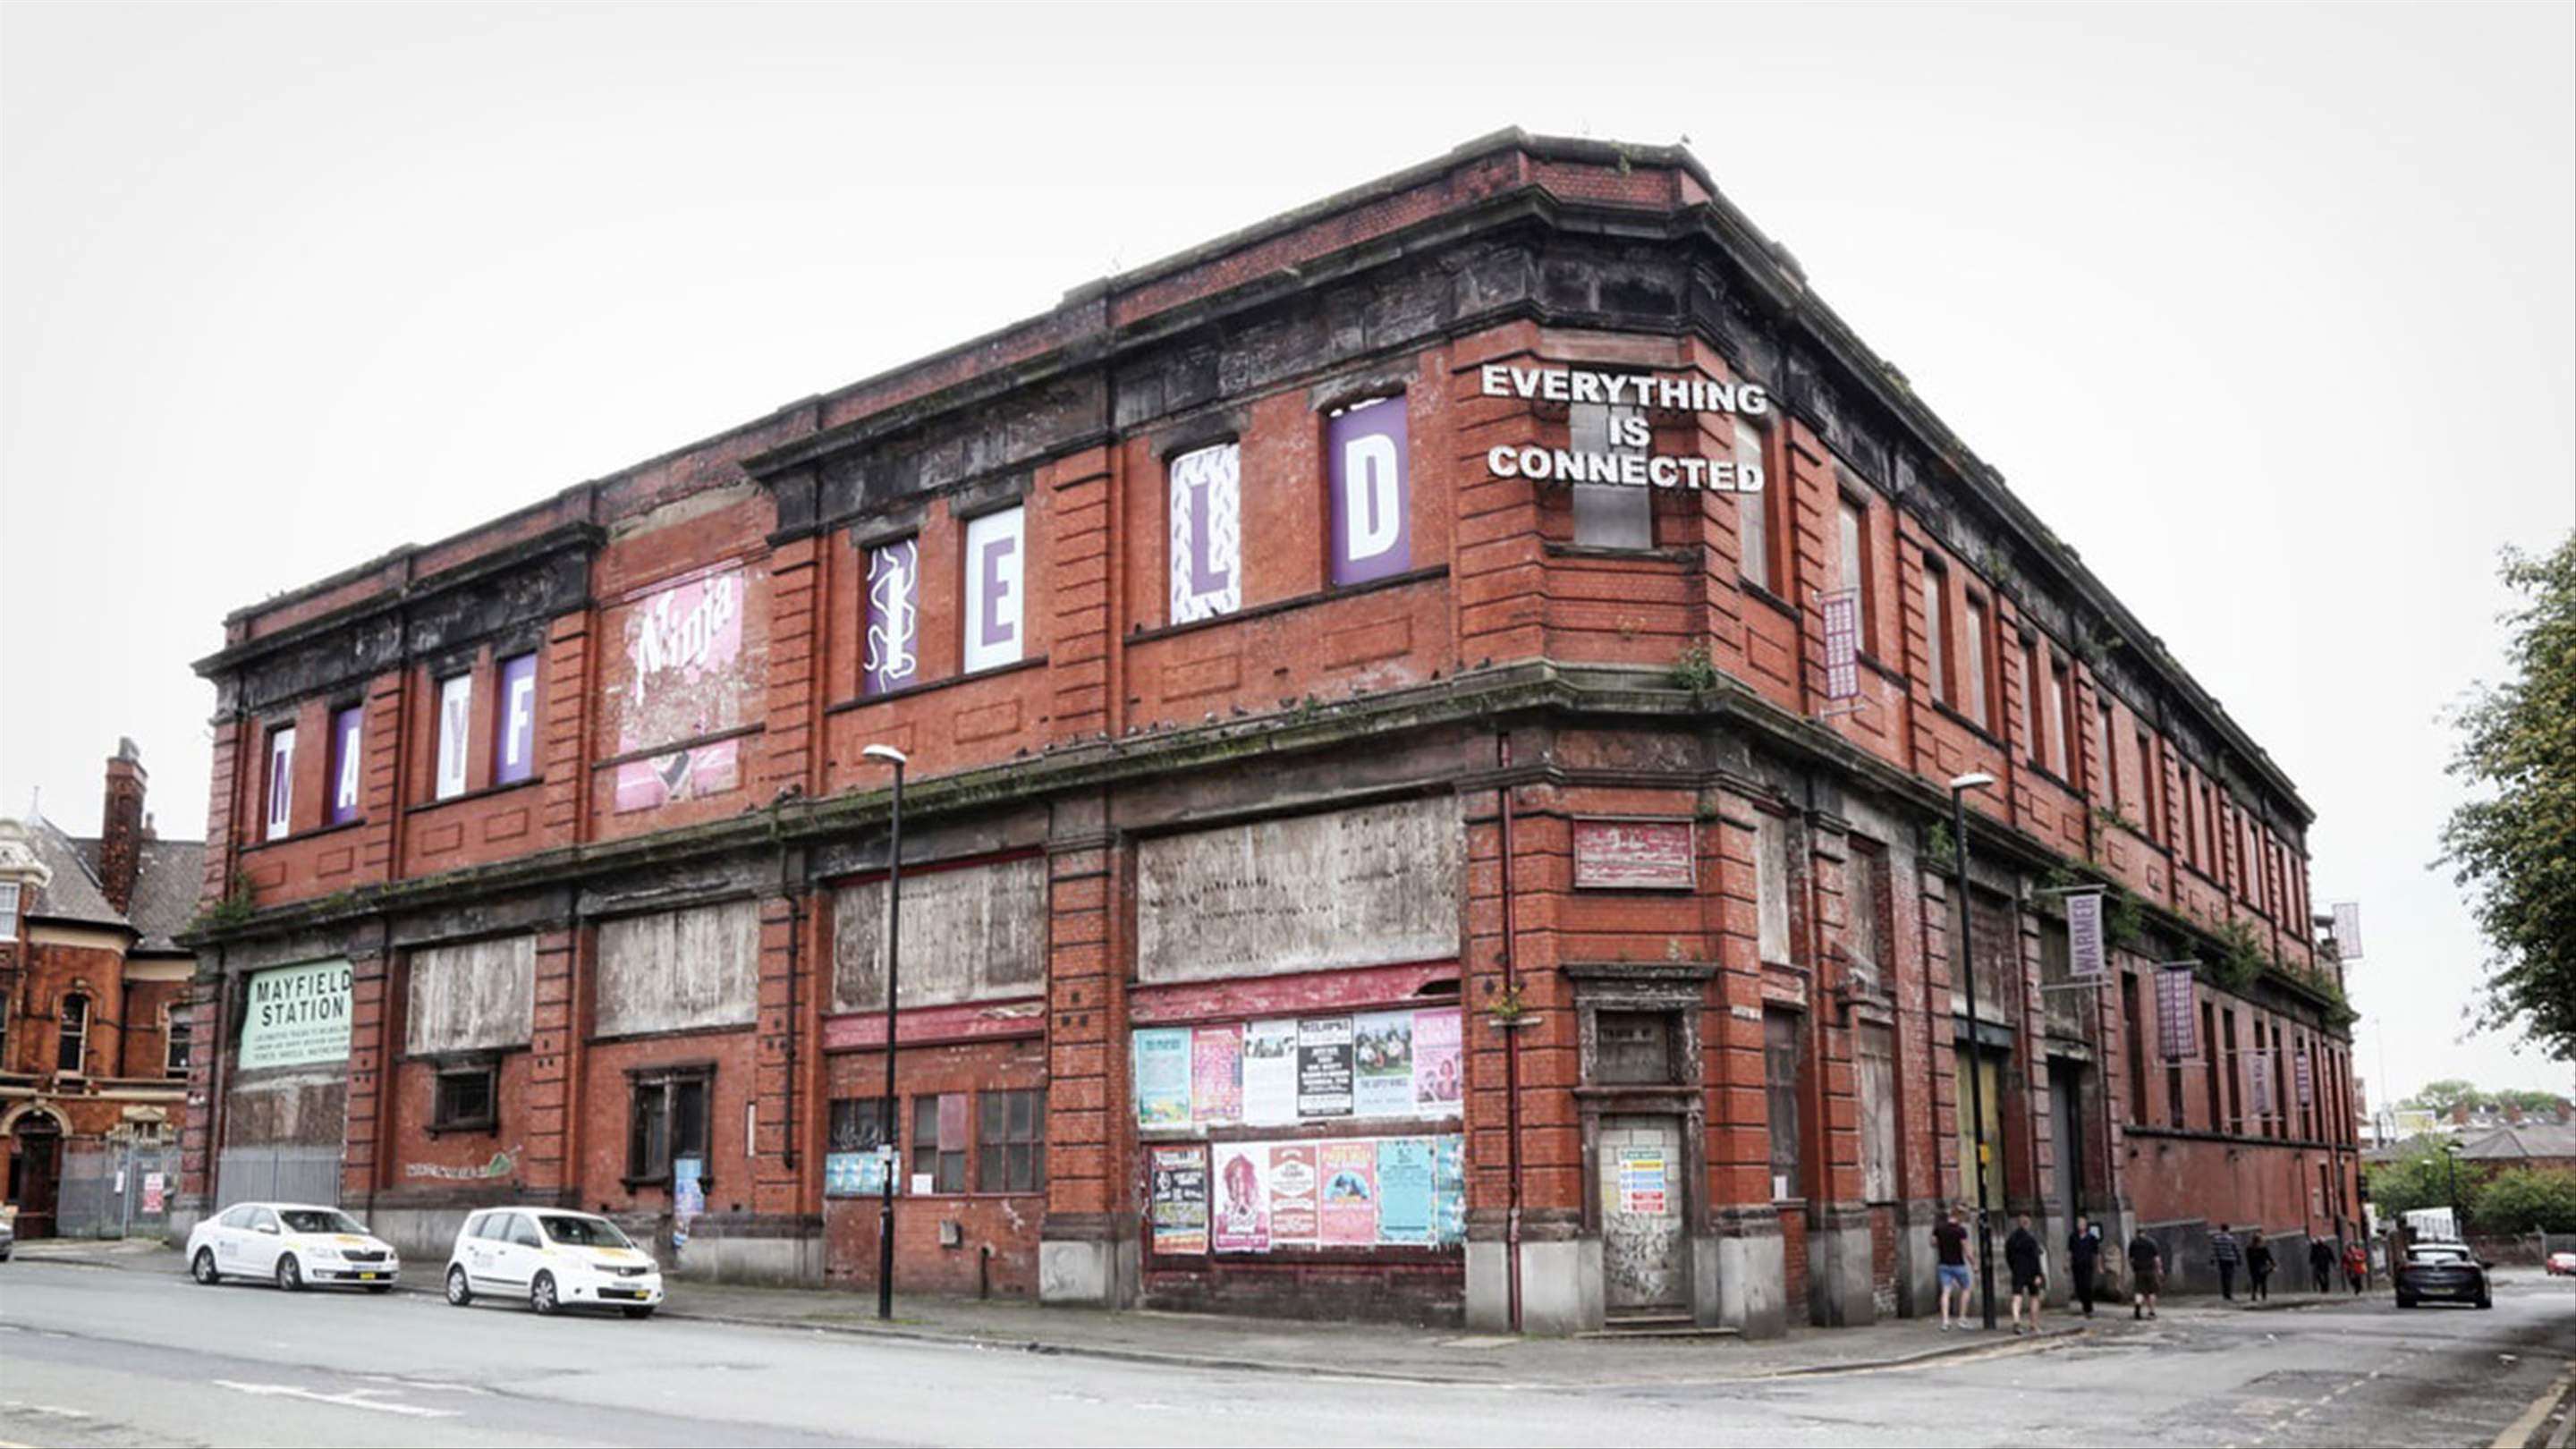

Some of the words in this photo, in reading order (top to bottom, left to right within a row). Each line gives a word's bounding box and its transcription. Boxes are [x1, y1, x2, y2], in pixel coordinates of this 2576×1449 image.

[1481, 364, 1767, 415] EVERYTHING
[1609, 414, 1650, 447] IS
[1487, 445, 1765, 492] CONNECTED
[981, 536, 1015, 647] E
[1191, 483, 1228, 597] L
[1345, 434, 1400, 562] D
[2072, 897, 2098, 973] WARMER
[257, 969, 352, 1003] MAYFIELD
[261, 996, 344, 1028] STATION
